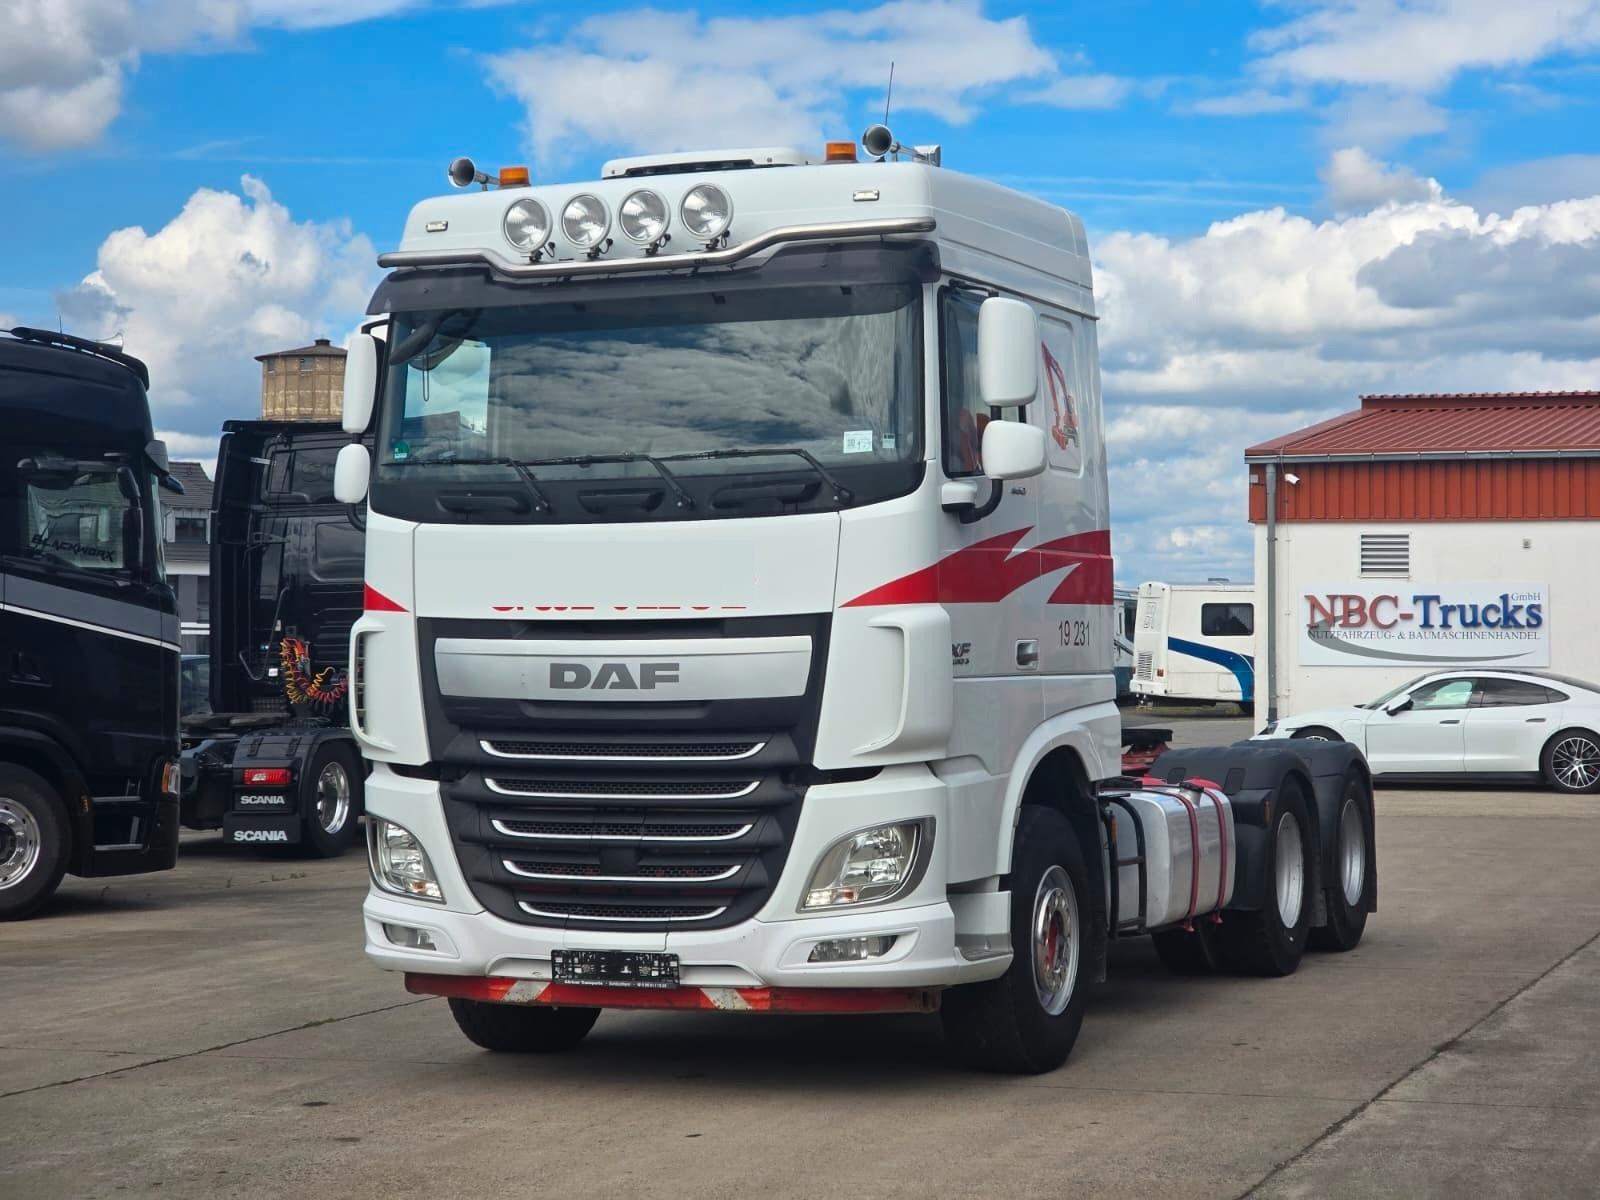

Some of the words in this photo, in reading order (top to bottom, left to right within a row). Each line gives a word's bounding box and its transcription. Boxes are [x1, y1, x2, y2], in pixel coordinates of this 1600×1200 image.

[1511, 592, 1541, 601] GmbH
[1304, 593, 1542, 629] NBC-Trucks
[1058, 620, 1071, 647] 19
[1073, 620, 1091, 647] 231
[1308, 630, 1396, 641] NUTZFAHRZEUG-
[1397, 630, 1406, 640] &
[1408, 630, 1541, 641] BAUMASCHINENHANDEL
[549, 662, 680, 691] DAF
[240, 795, 285, 805] SCANIA
[233, 830, 288, 841] SCANIA
